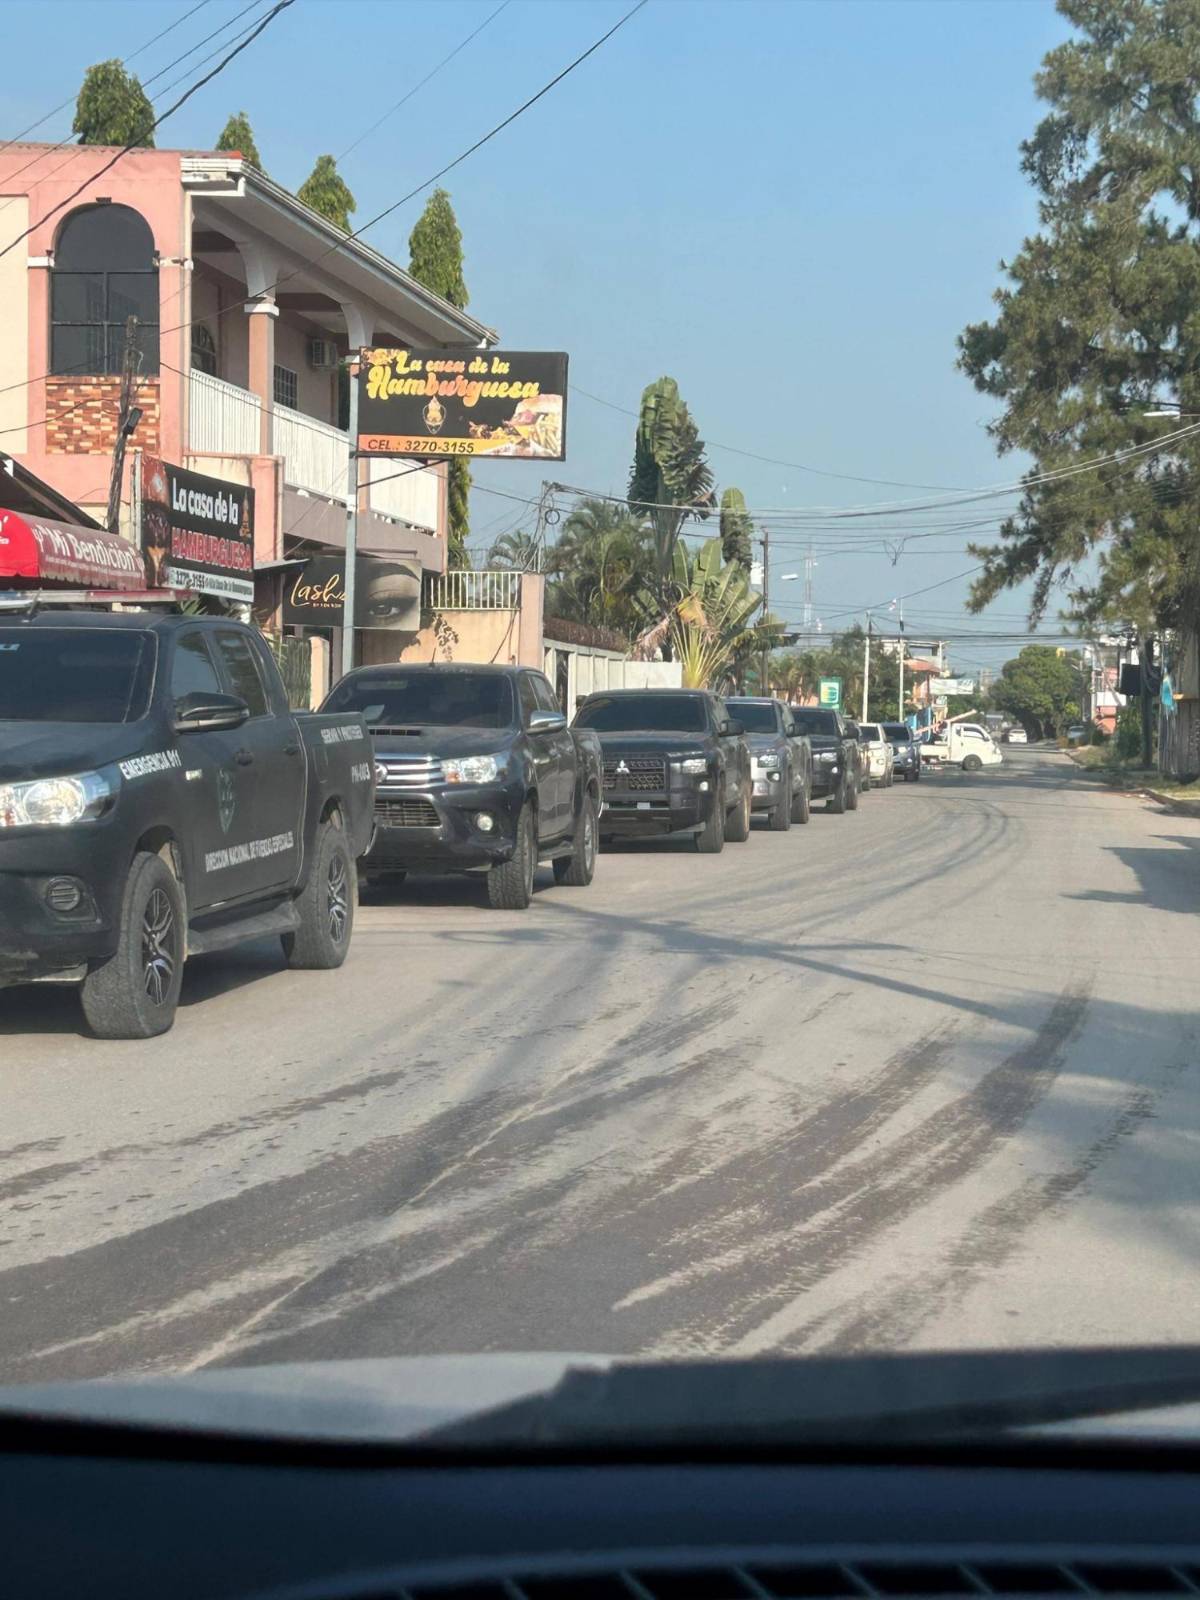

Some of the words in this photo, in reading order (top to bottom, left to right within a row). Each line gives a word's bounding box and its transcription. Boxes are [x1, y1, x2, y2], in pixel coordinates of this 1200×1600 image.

[396, 350, 422, 374] La
[426, 360, 466, 374] casa
[468, 356, 488, 374] de
[491, 356, 510, 374] la
[366, 365, 540, 407] Hamburguesa
[405, 440, 474, 453] 3270-3155
[173, 477, 187, 512] La
[188, 489, 213, 519] casa
[215, 491, 228, 523] de
[229, 493, 239, 525] la
[172, 526, 252, 572] HAMBURGUESA
